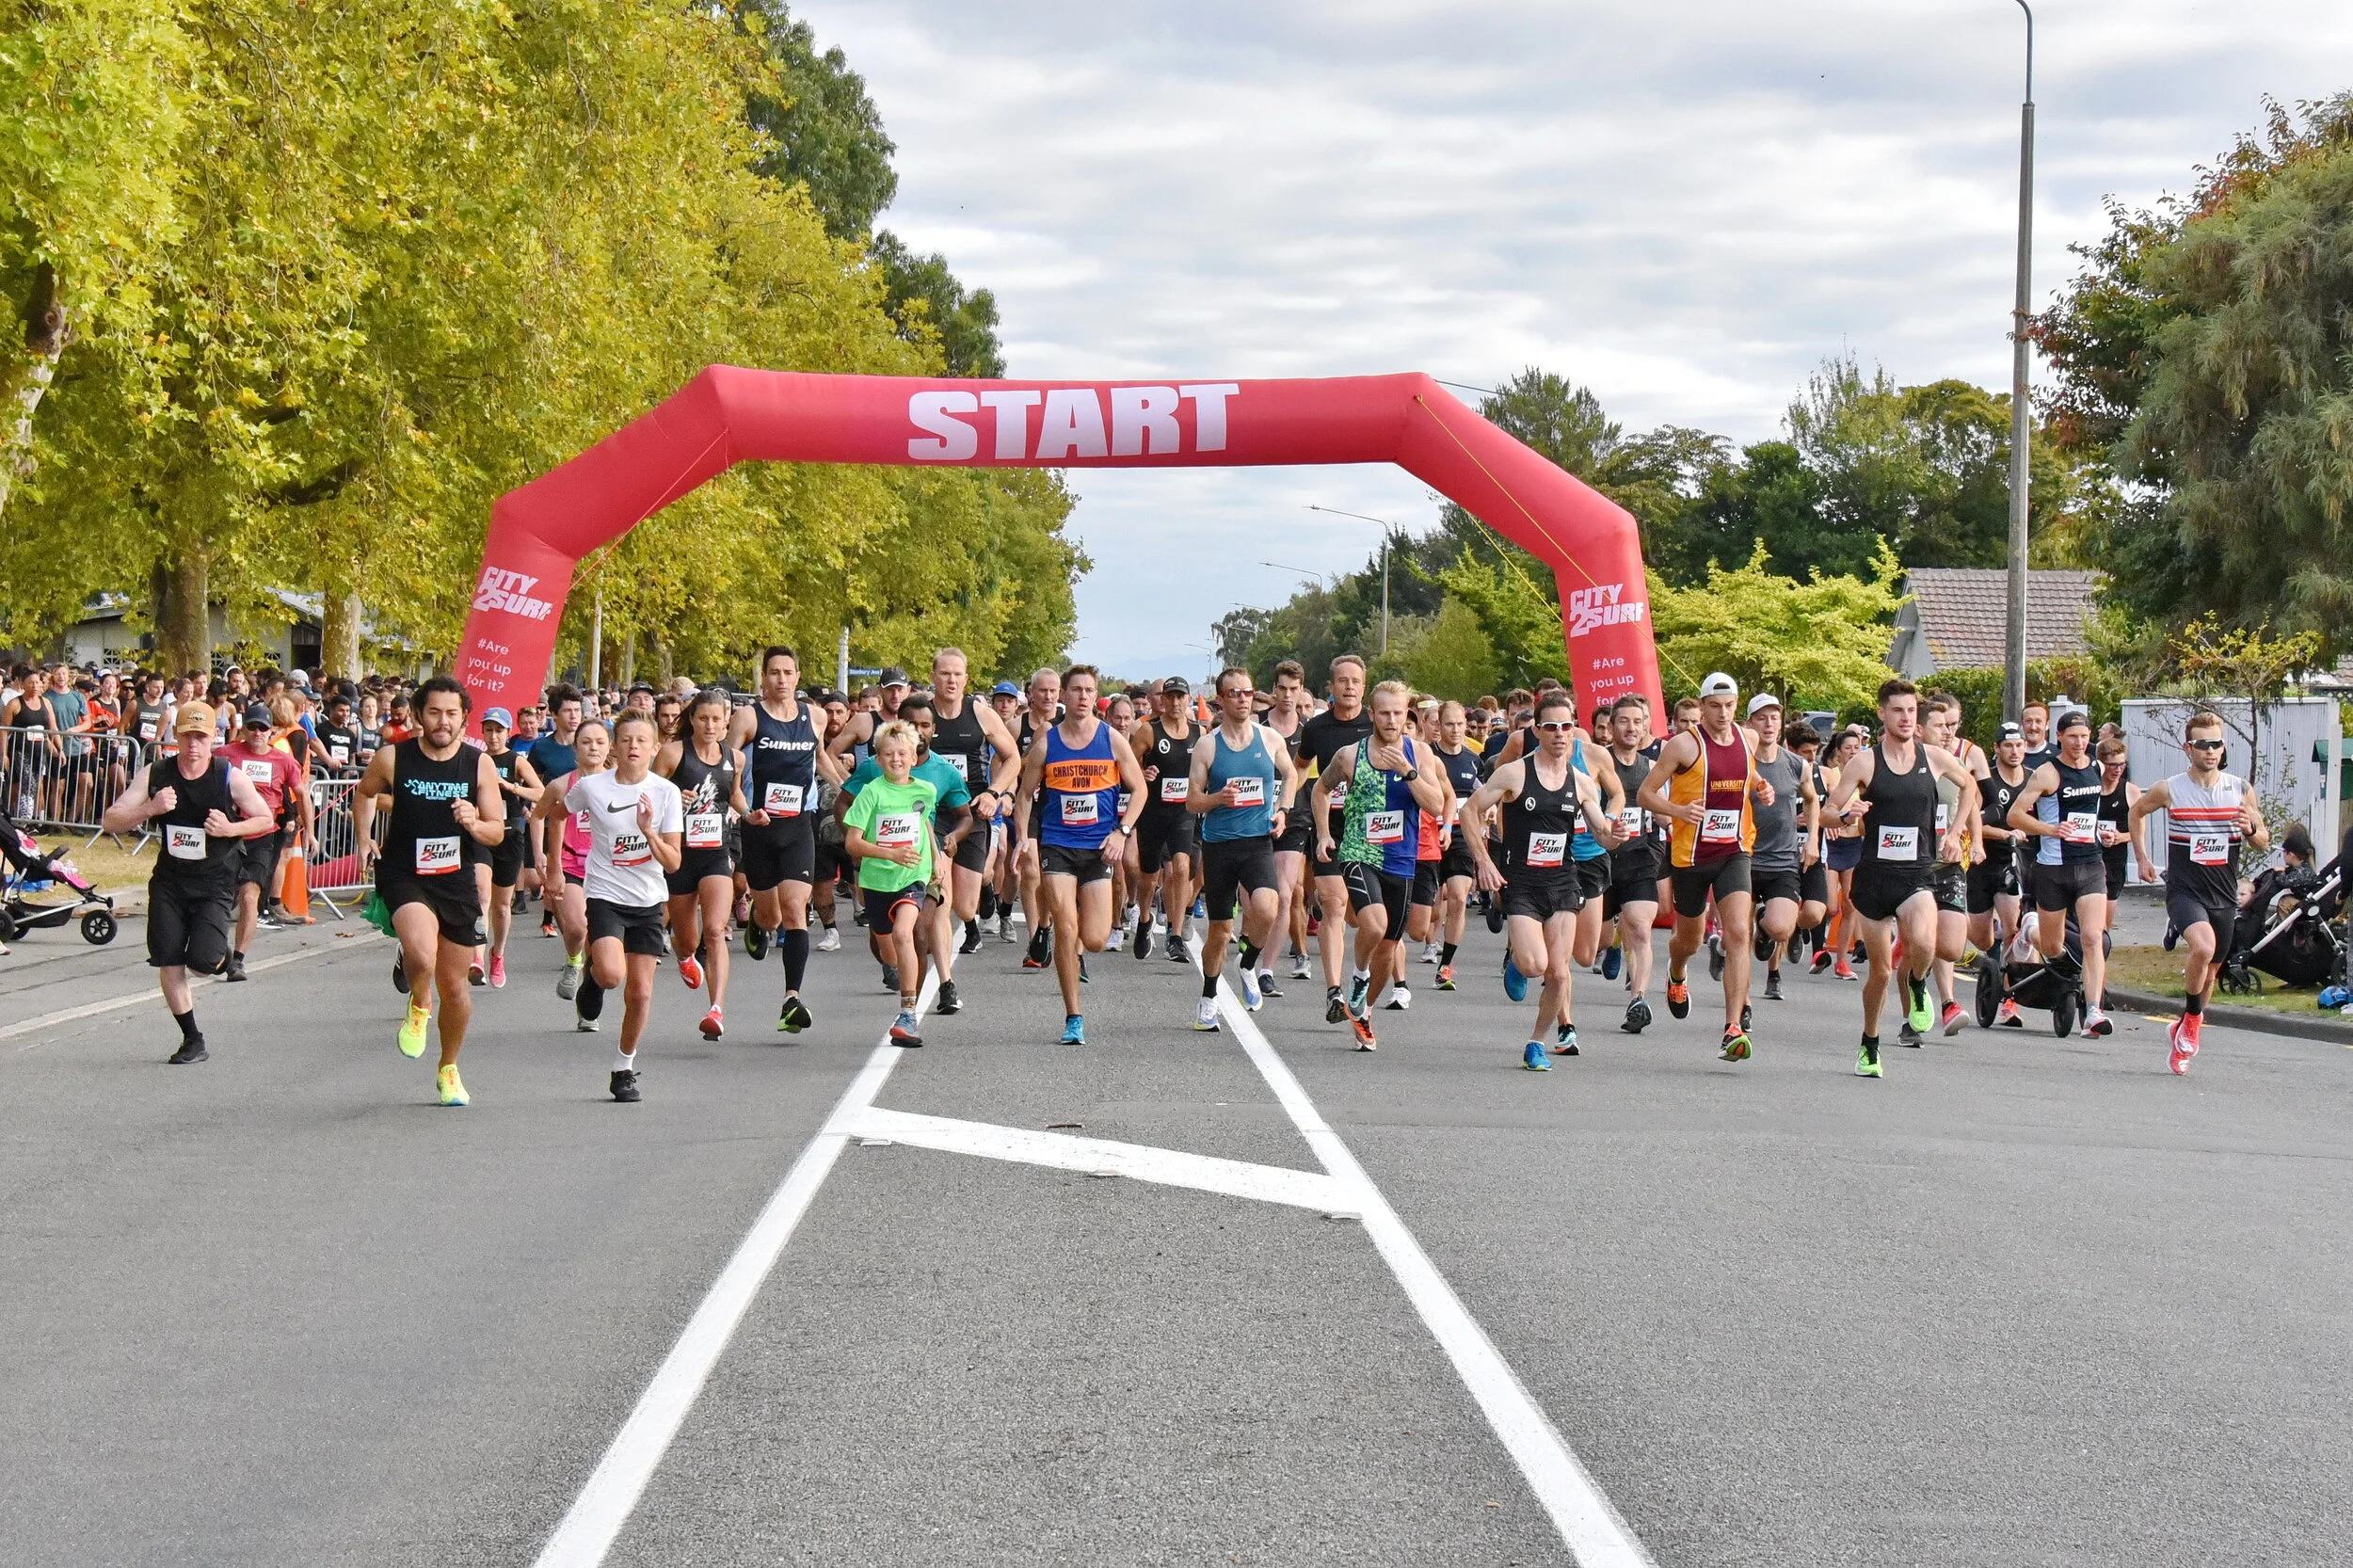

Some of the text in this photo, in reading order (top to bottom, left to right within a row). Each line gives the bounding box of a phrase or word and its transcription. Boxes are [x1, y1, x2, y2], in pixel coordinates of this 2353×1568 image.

[908, 383, 1240, 461] START
[481, 566, 539, 595] CITY
[472, 584, 553, 621] 2SURF
[1570, 584, 1624, 610] CITY
[1569, 601, 1644, 638] 2SURF
[477, 638, 509, 656] #Are
[468, 656, 512, 677] you up
[1593, 657, 1625, 671] #Are
[467, 673, 504, 693] for it?
[1590, 674, 1634, 693] you up
[758, 737, 815, 751] Sumner
[246, 768, 269, 776] 2SURF
[1052, 764, 1109, 778] CHRISTCHURCH
[417, 781, 469, 792] ANYTIME
[1071, 776, 1091, 789] AVON
[1710, 779, 1745, 789] UNIVERSITY
[418, 789, 469, 798] FITNESS
[1238, 785, 1259, 793] SURF
[2062, 785, 2102, 798] Sumne
[767, 793, 799, 804] 2SURF
[1064, 805, 1095, 815] 2SURF
[881, 819, 904, 827] CITY
[1372, 816, 1393, 824] CITY
[1709, 814, 1731, 823] CITY
[689, 824, 719, 836] 2SURF
[878, 824, 911, 837] 2SURF
[1369, 822, 1401, 832] 2SURF
[1705, 820, 1737, 831] 2SURF
[171, 837, 201, 848] 2SURF
[615, 835, 640, 845] CITY
[1884, 833, 1905, 841] CITY
[424, 843, 449, 852] CITY
[1530, 843, 1563, 855] 2SURF
[1881, 838, 1913, 849] 2SURF
[2192, 844, 2226, 855] 2SURF
[420, 849, 457, 862] 2SURF
